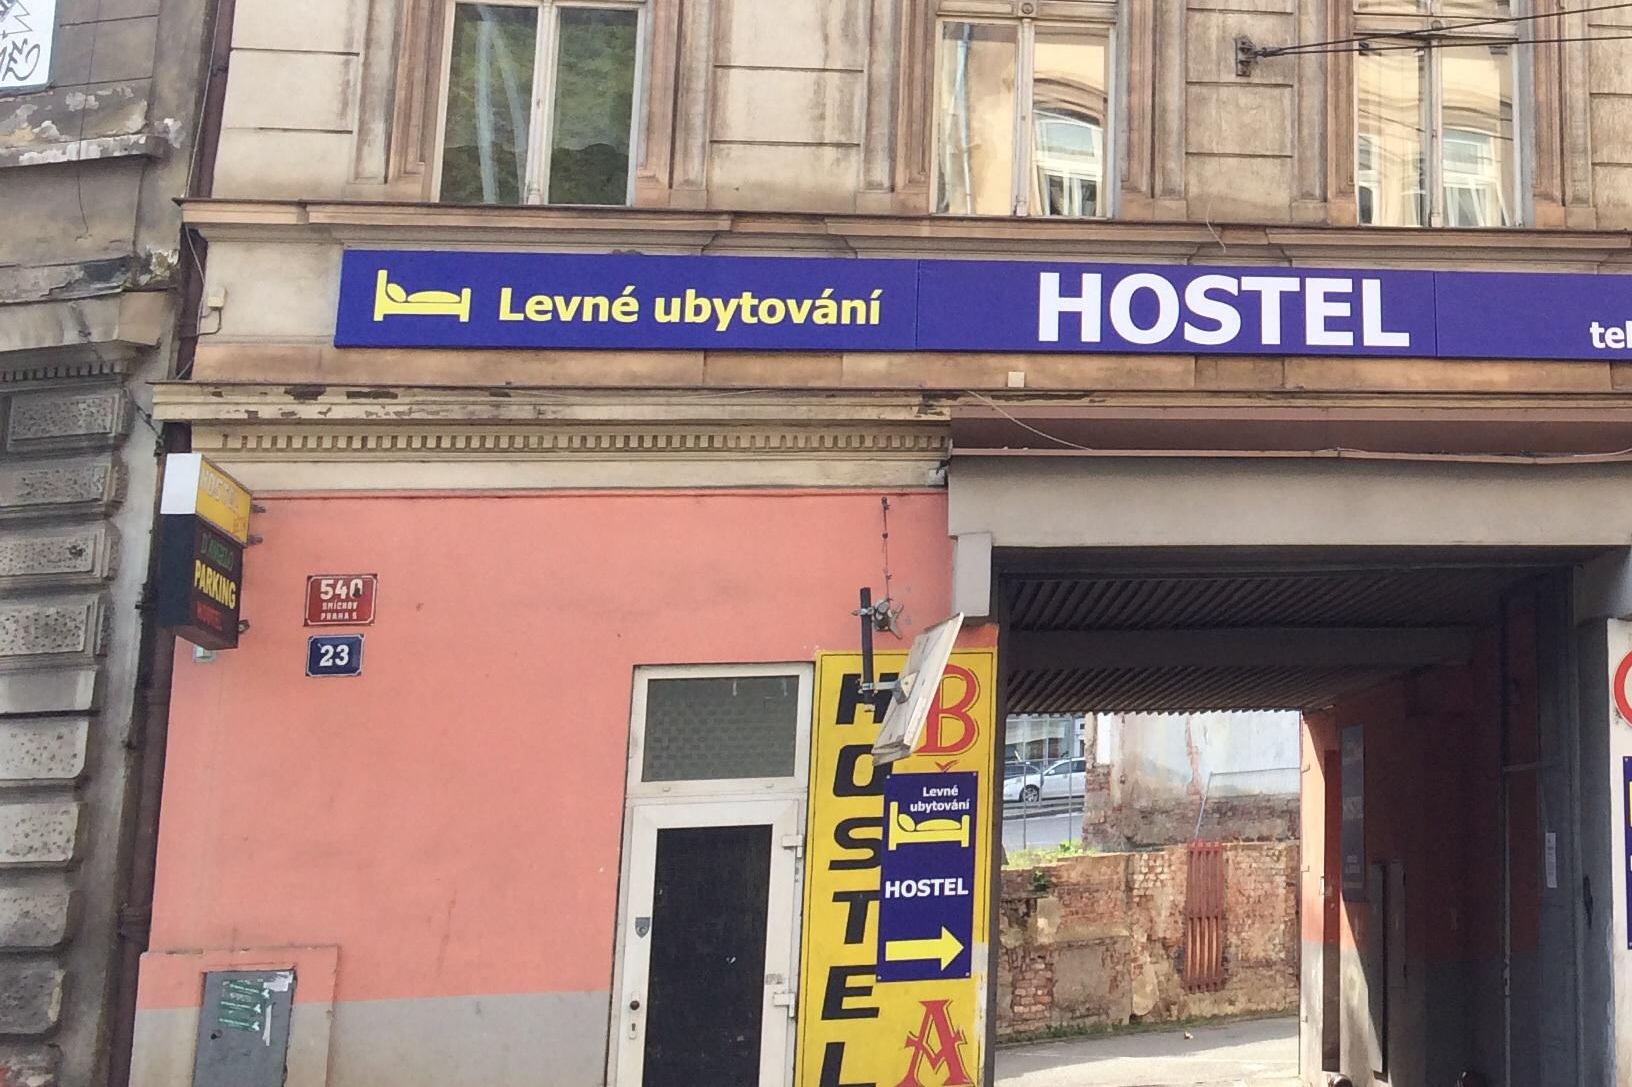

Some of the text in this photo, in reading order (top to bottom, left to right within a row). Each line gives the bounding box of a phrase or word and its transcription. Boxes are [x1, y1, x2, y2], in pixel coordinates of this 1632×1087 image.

[499, 285, 883, 332] Levné ubytování
[1038, 271, 1411, 348] HOSTEL
[193, 559, 236, 610] PARKING
[320, 578, 364, 600] 540
[322, 599, 358, 611] SMÍCHOV
[320, 612, 350, 621] PRAHA
[319, 644, 350, 667] 23
[922, 785, 959, 798] Levné
[909, 797, 970, 813] ubytování
[884, 877, 969, 899] HOSTEL
